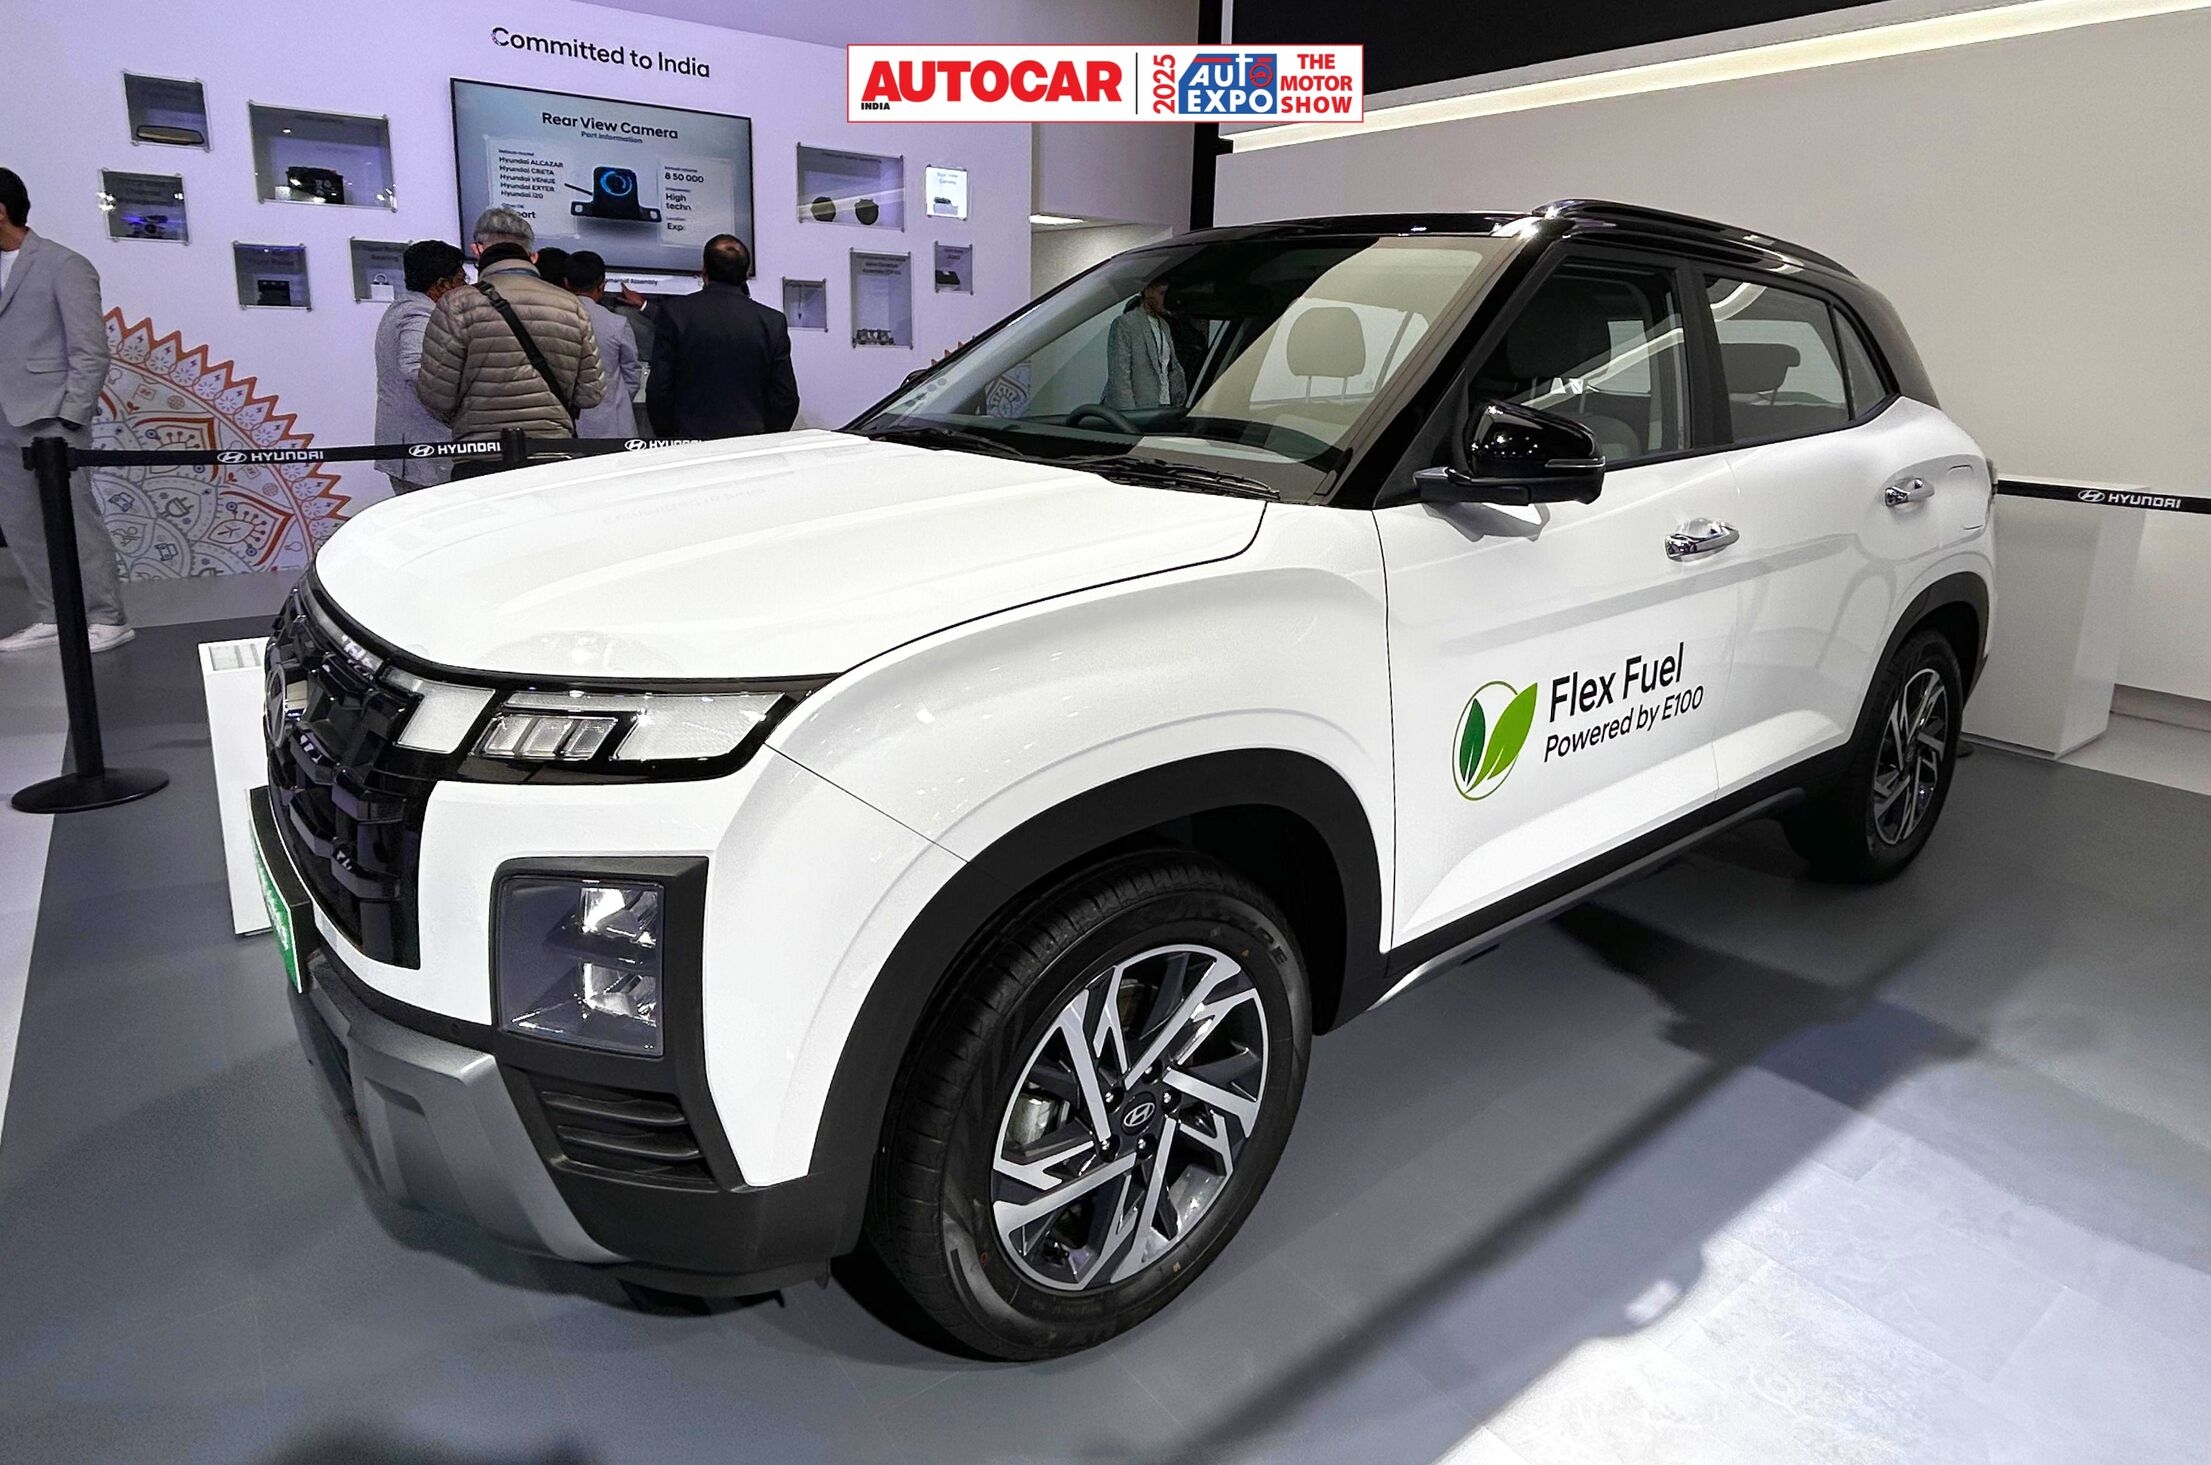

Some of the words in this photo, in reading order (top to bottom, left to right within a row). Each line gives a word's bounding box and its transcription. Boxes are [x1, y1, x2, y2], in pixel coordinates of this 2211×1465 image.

[491, 27, 624, 65] Committed
[630, 49, 653, 70] to
[658, 51, 710, 78] India
[542, 112, 578, 127] Rear
[580, 116, 618, 132] View
[620, 122, 679, 139] Camera
[531, 159, 564, 168] ALCAZAR
[531, 167, 555, 175] CRETA
[665, 172, 671, 180] 8
[673, 173, 685, 181] 50
[665, 193, 687, 203] High
[437, 441, 501, 455] HYUNDAI
[251, 450, 324, 462] HYUNDAI
[2108, 492, 2182, 509] HYUNDAI
[1550, 671, 1616, 723] Flex
[1622, 641, 1685, 700] Fuel
[1544, 707, 1634, 763] Powered
[1635, 703, 1660, 731] by
[1661, 684, 1705, 721] E100
